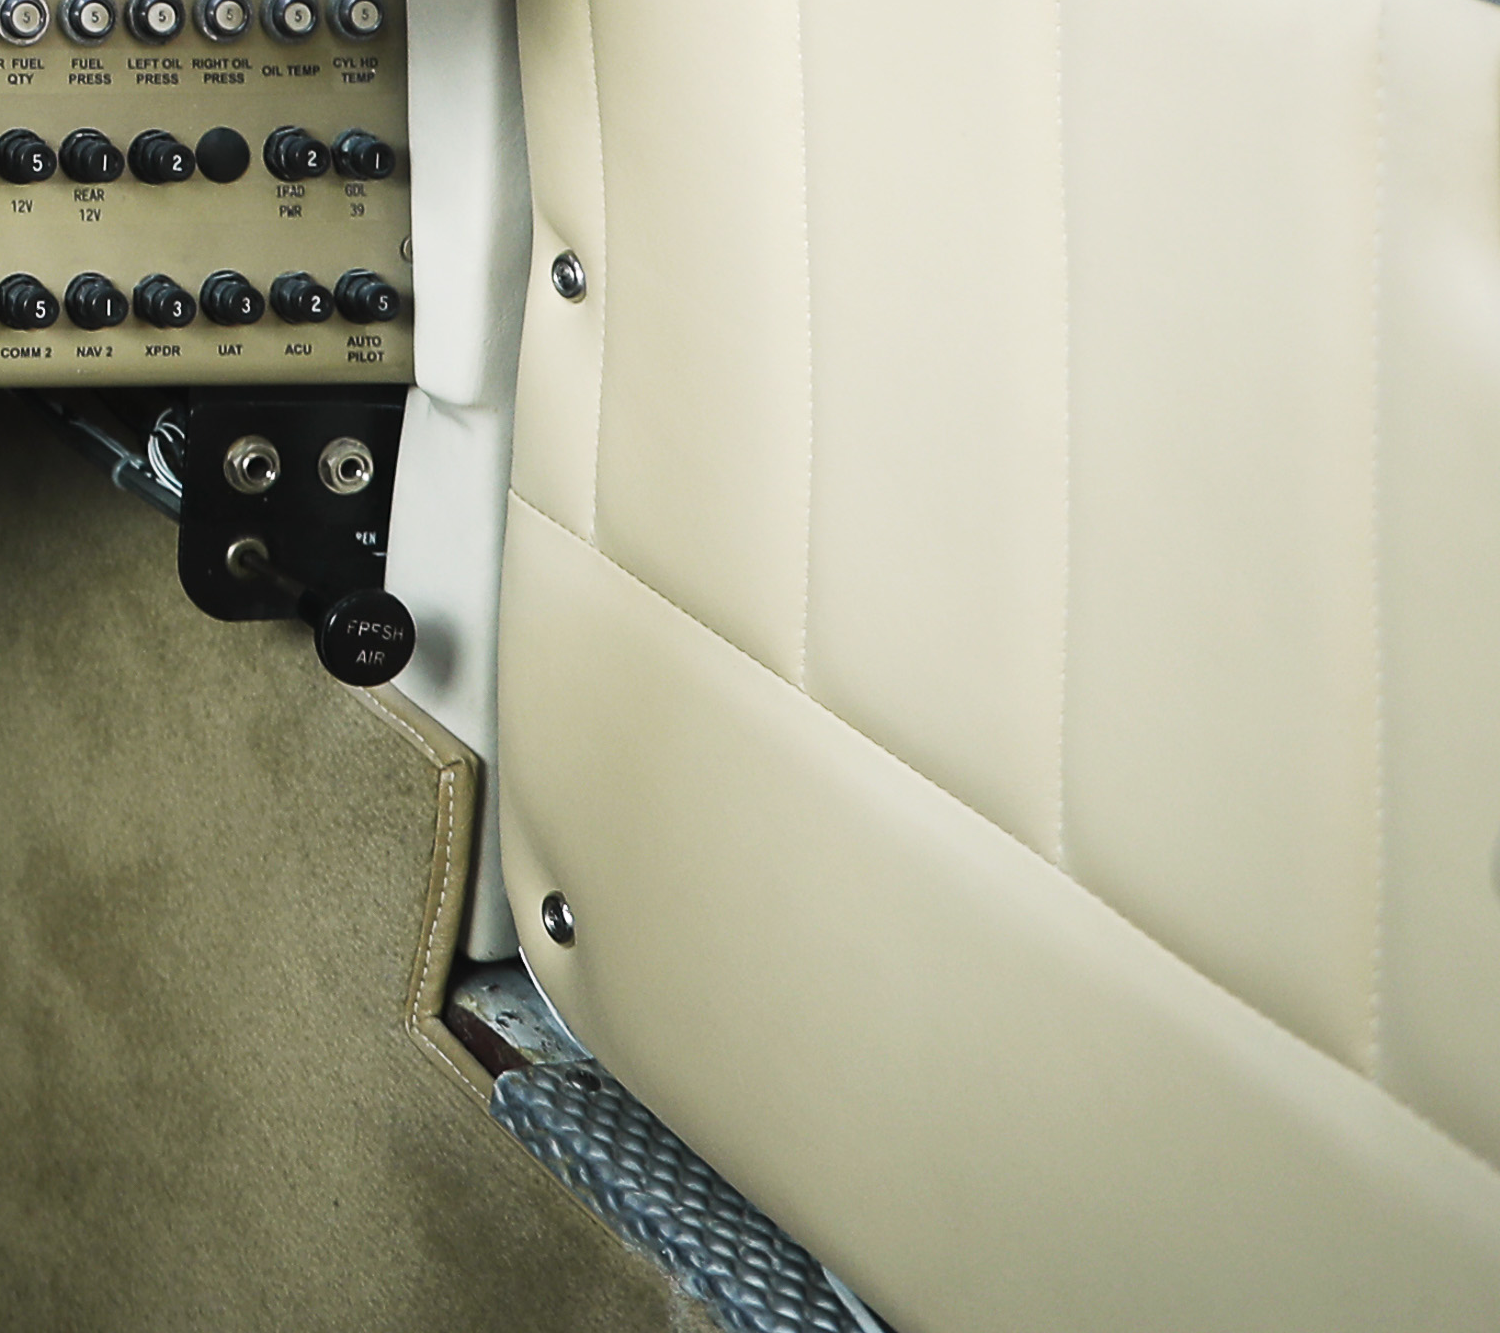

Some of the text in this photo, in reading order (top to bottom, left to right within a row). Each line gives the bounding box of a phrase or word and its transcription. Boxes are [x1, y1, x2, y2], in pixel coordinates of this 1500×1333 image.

[71, 58, 103, 70] FUEL
[69, 73, 111, 84] PRESS
[145, 345, 180, 356] XPDR
[218, 344, 243, 355] UAT
[285, 344, 312, 354] ACU
